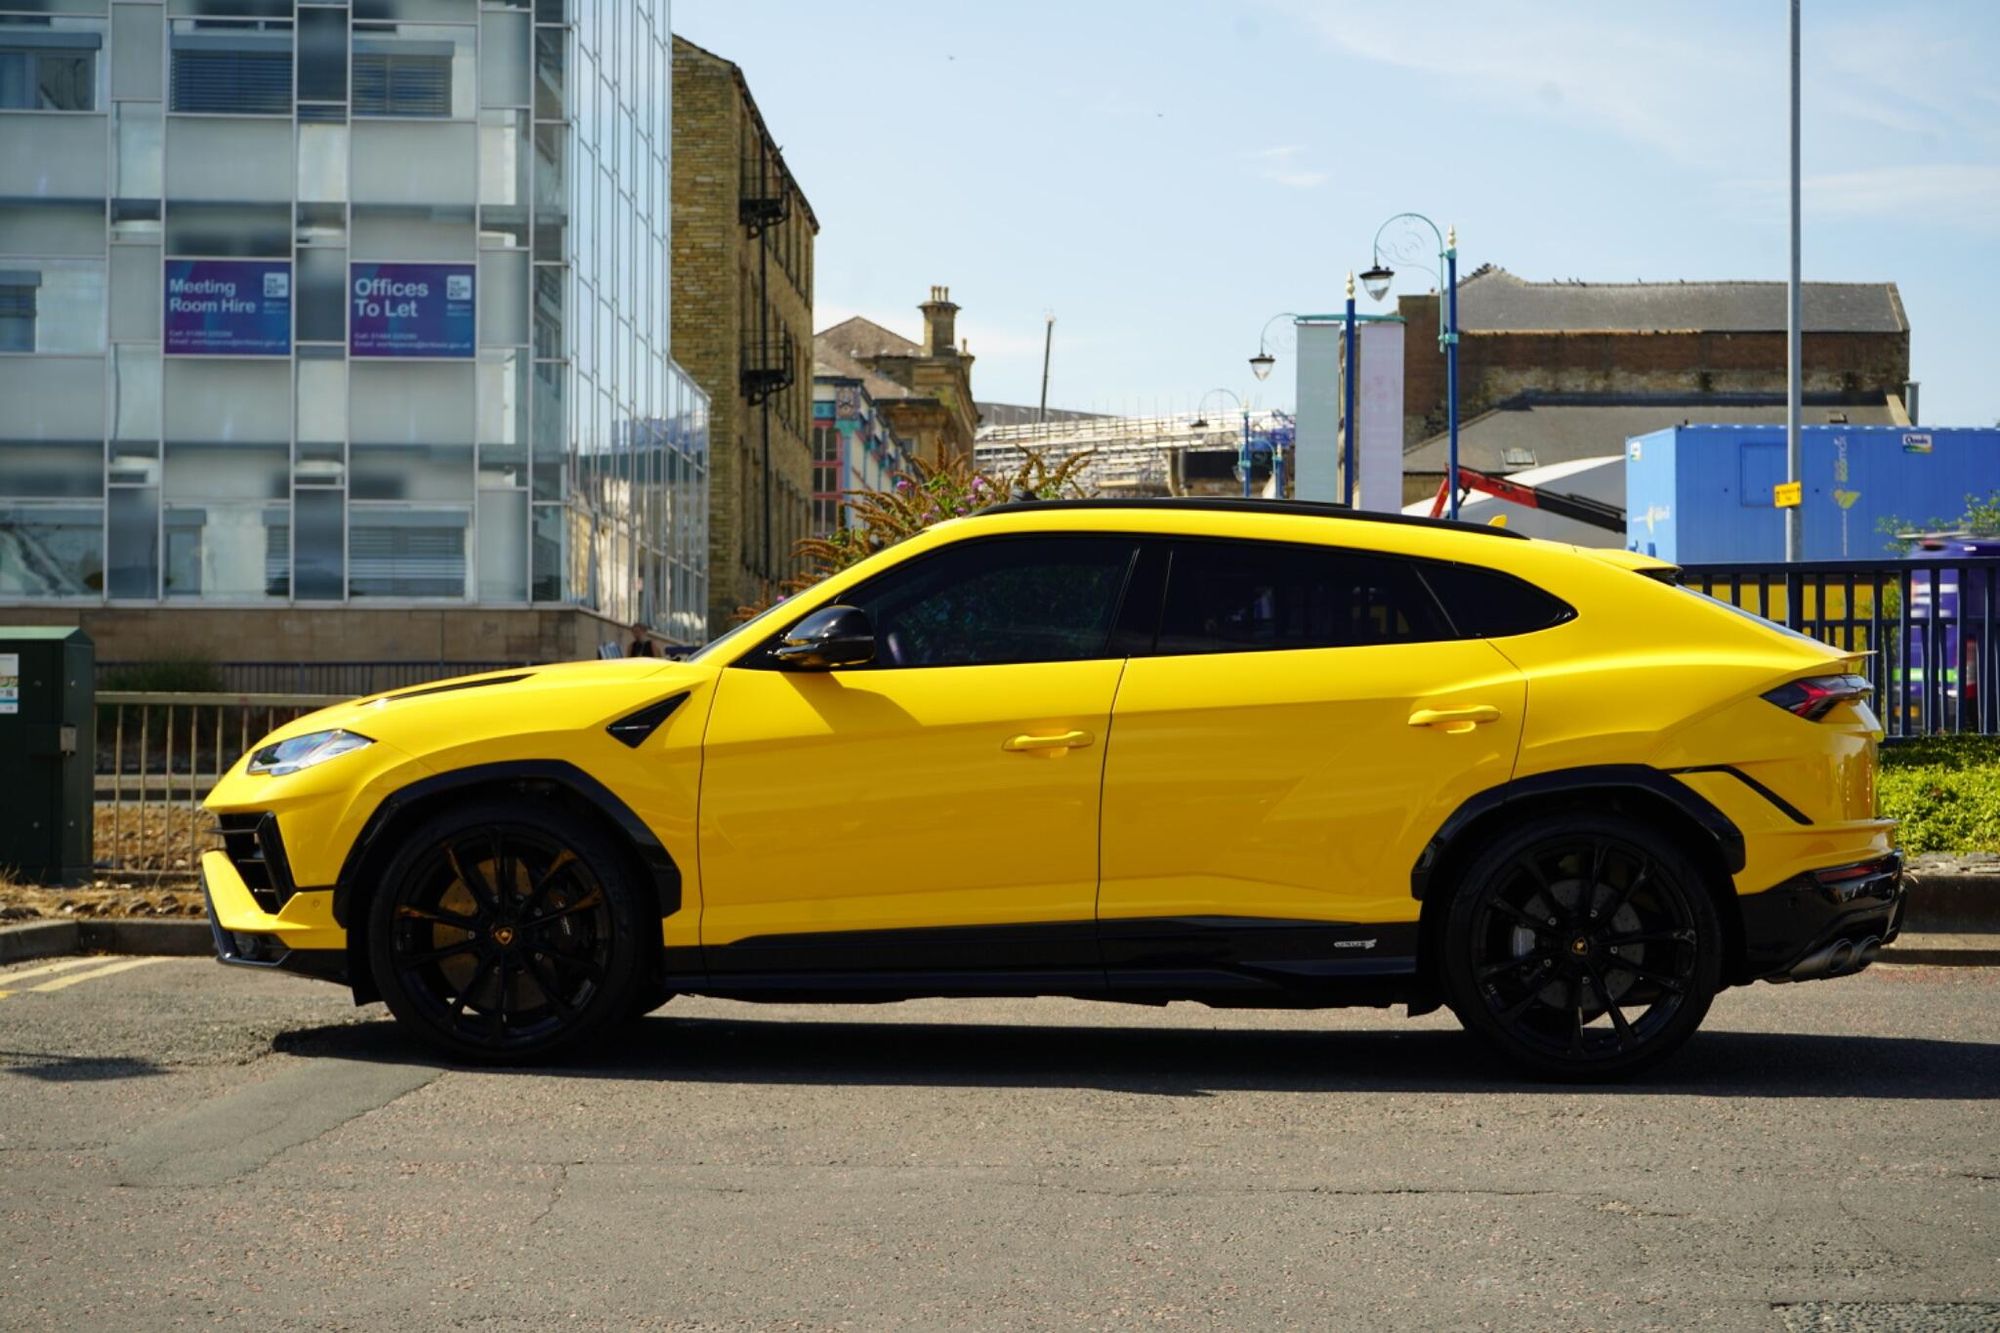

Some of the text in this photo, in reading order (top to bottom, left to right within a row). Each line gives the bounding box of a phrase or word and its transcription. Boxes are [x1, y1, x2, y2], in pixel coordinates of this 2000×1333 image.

[169, 278, 236, 297] Meeting
[354, 277, 429, 297] Offices
[169, 297, 256, 313] Room Hire
[354, 299, 418, 317] To Let
